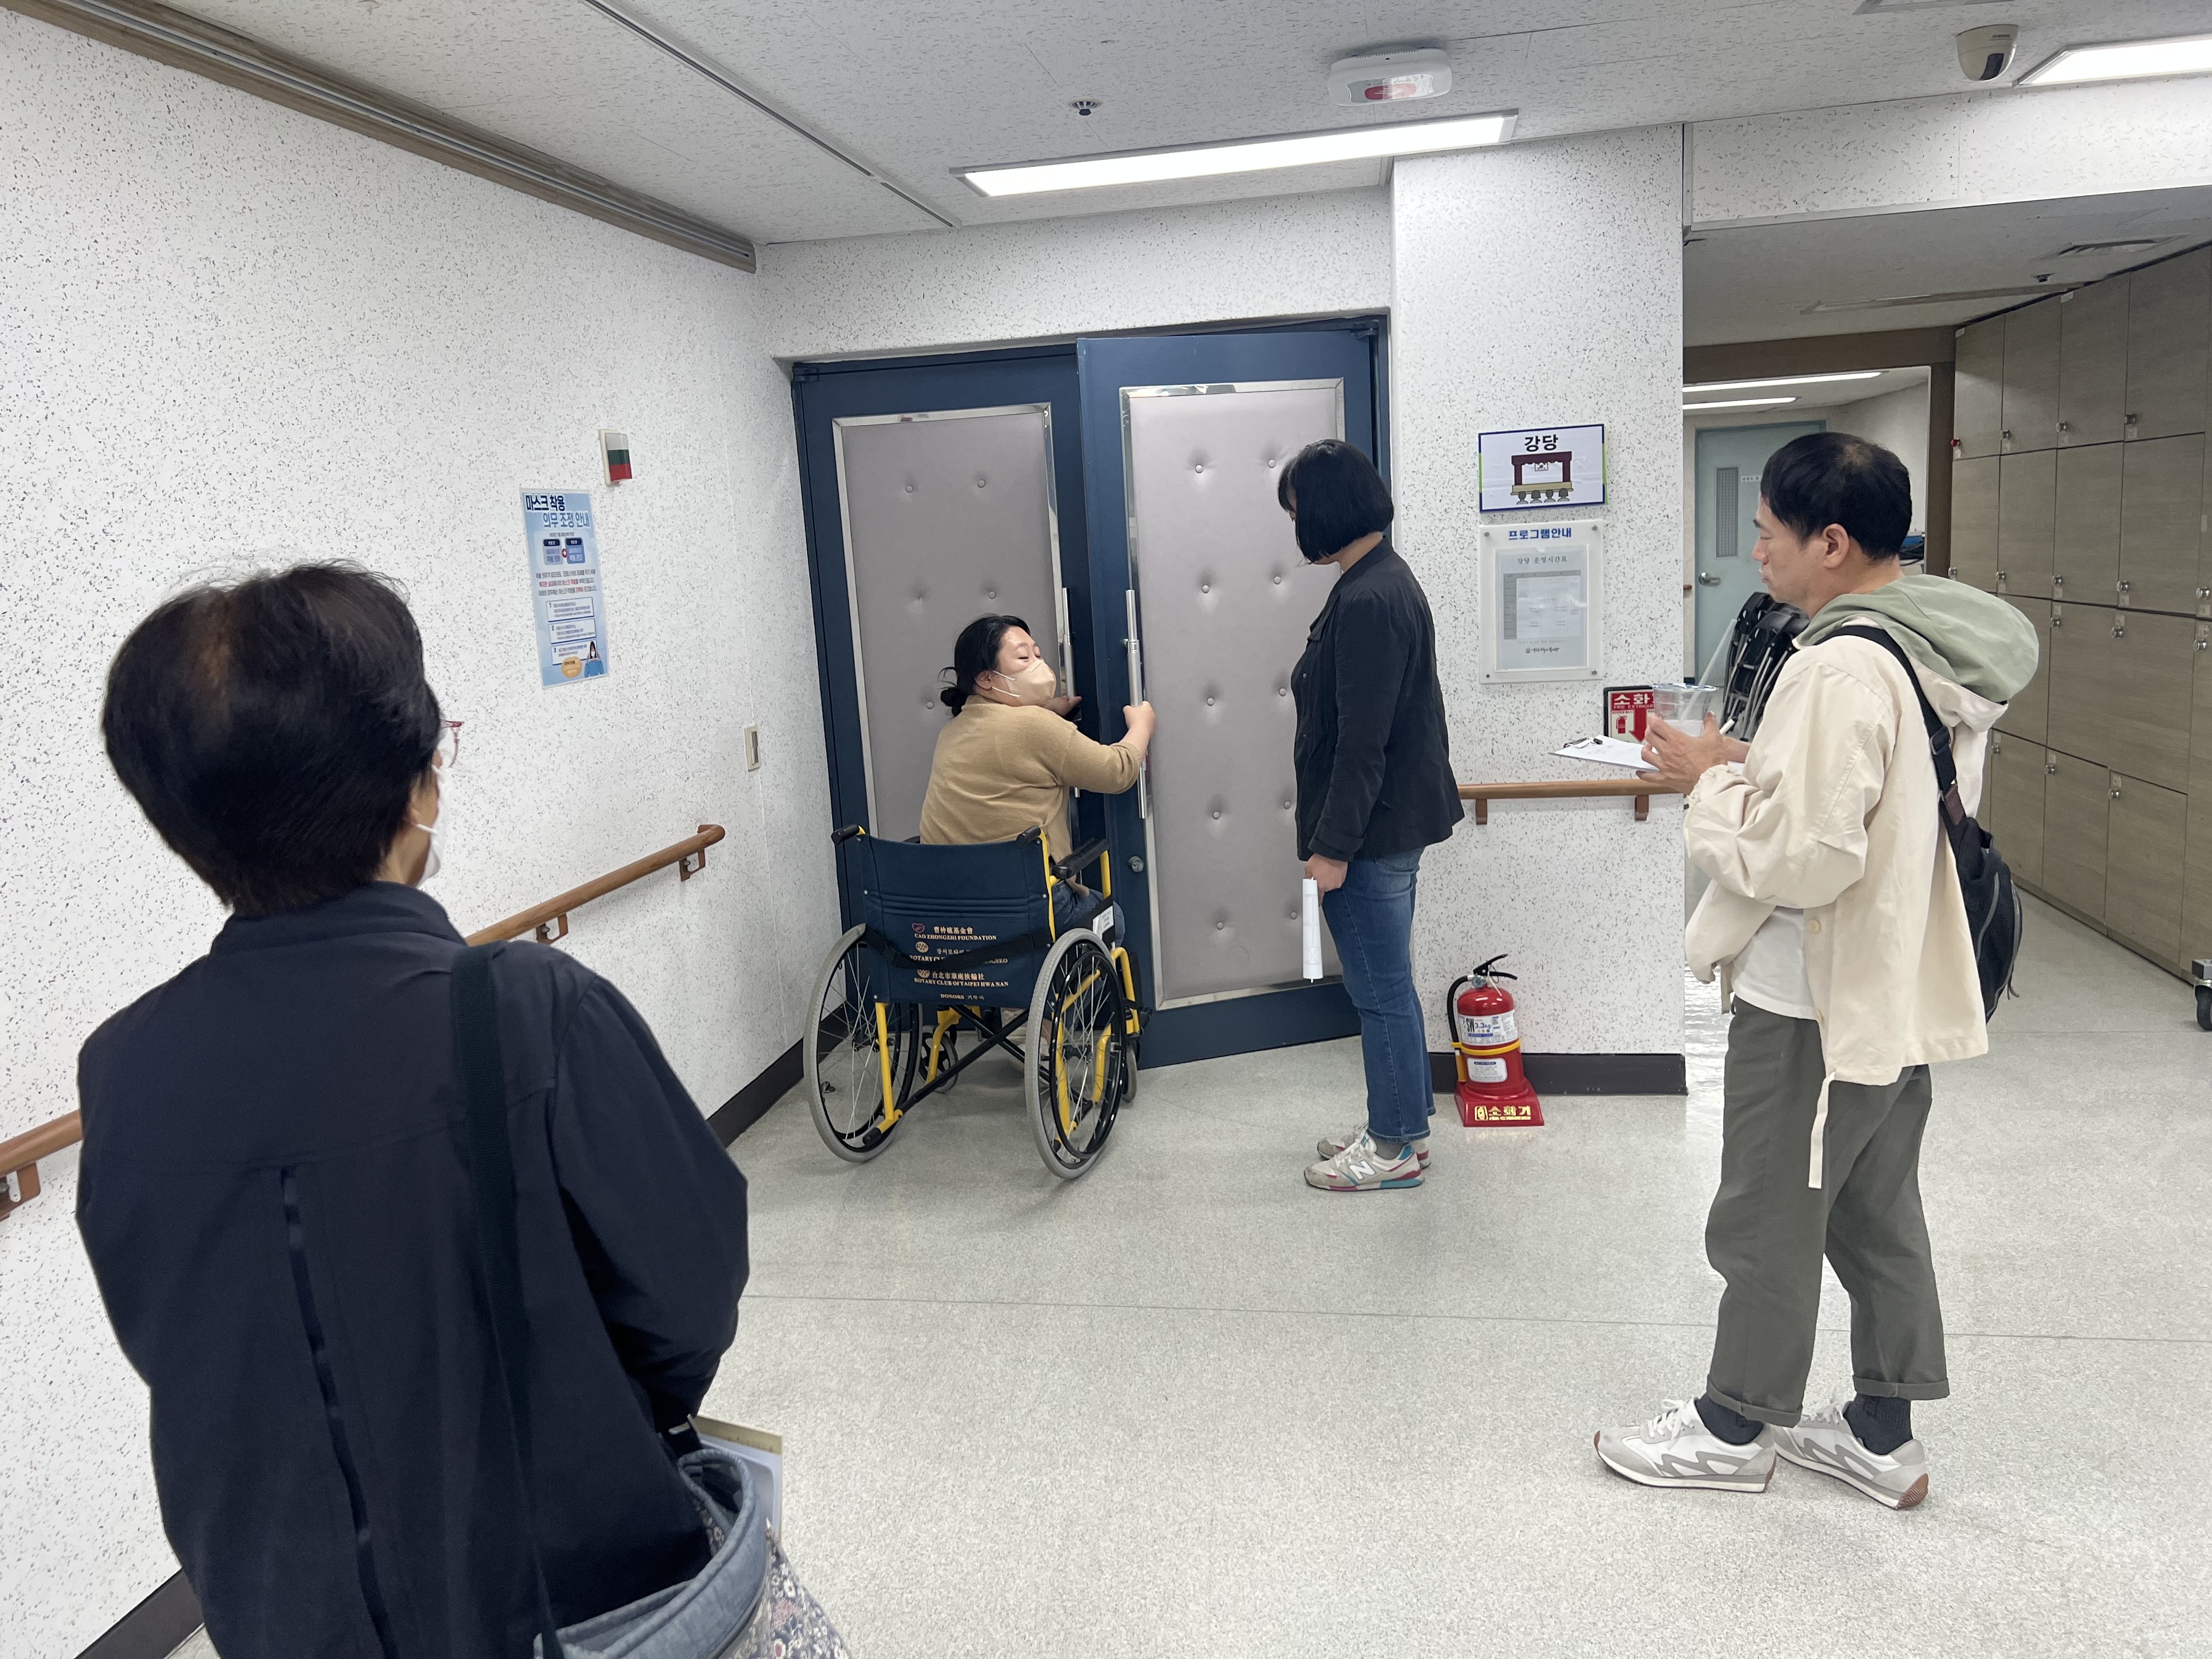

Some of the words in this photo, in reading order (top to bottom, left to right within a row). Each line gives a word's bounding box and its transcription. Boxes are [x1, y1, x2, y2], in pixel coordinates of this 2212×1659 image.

[1524, 434, 1559, 452] 강당
[525, 494, 549, 511] 마스크
[550, 494, 565, 511] 착용
[543, 512, 558, 528] 의무
[560, 512, 574, 528] 조정
[575, 512, 590, 527] 안내
[1509, 528, 1572, 540] 프로그램안내
[1613, 693, 1655, 706] 소화
[1488, 1105, 1531, 1116] 소화기
[1348, 1159, 1377, 1180] N
